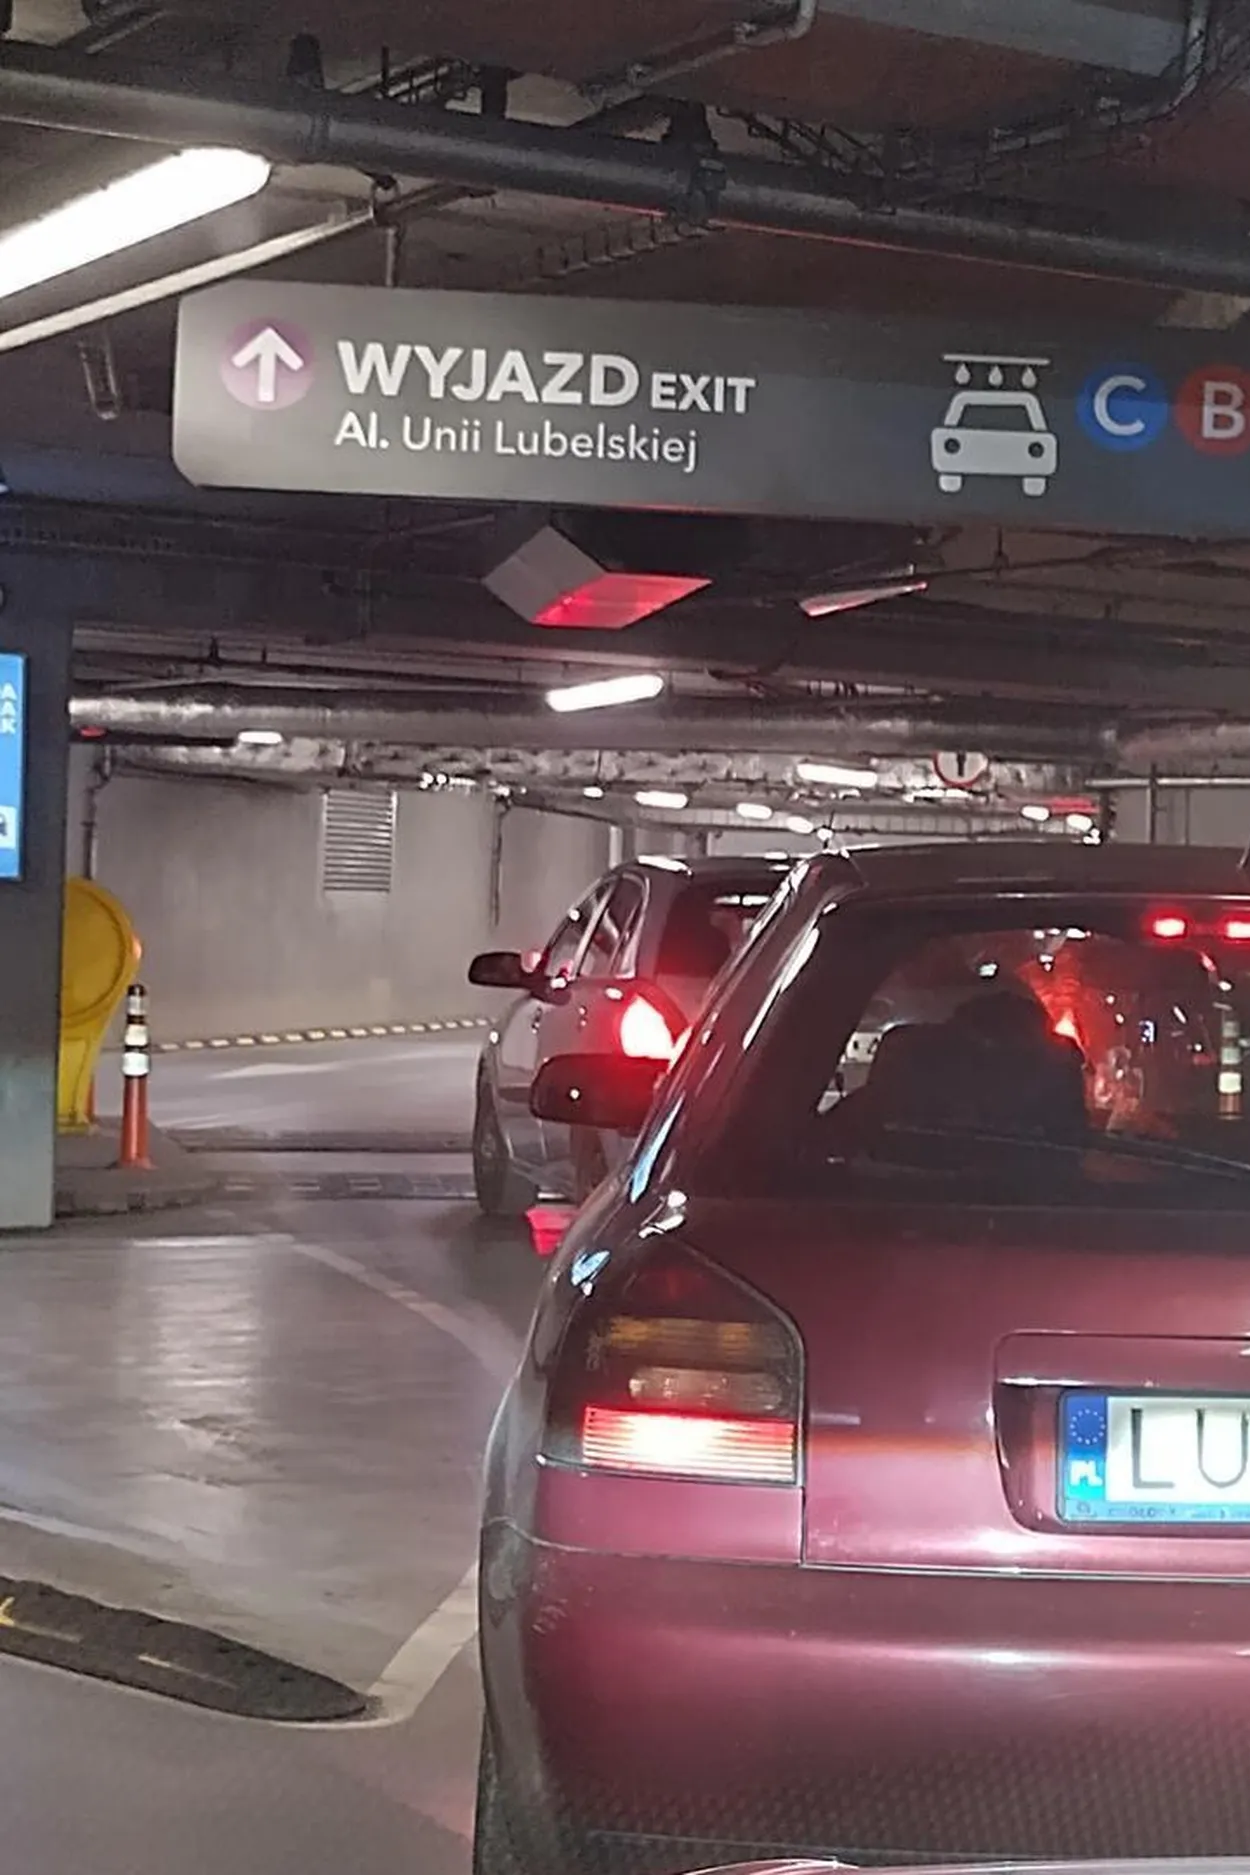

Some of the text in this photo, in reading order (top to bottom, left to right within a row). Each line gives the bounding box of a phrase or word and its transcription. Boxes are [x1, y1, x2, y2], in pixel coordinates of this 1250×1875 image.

[337, 340, 756, 413] WYJAZD EXIT
[1094, 375, 1246, 439] C B
[335, 410, 697, 473] Al. Unii Lubelskiej
[1130, 1407, 1250, 1489] LU
